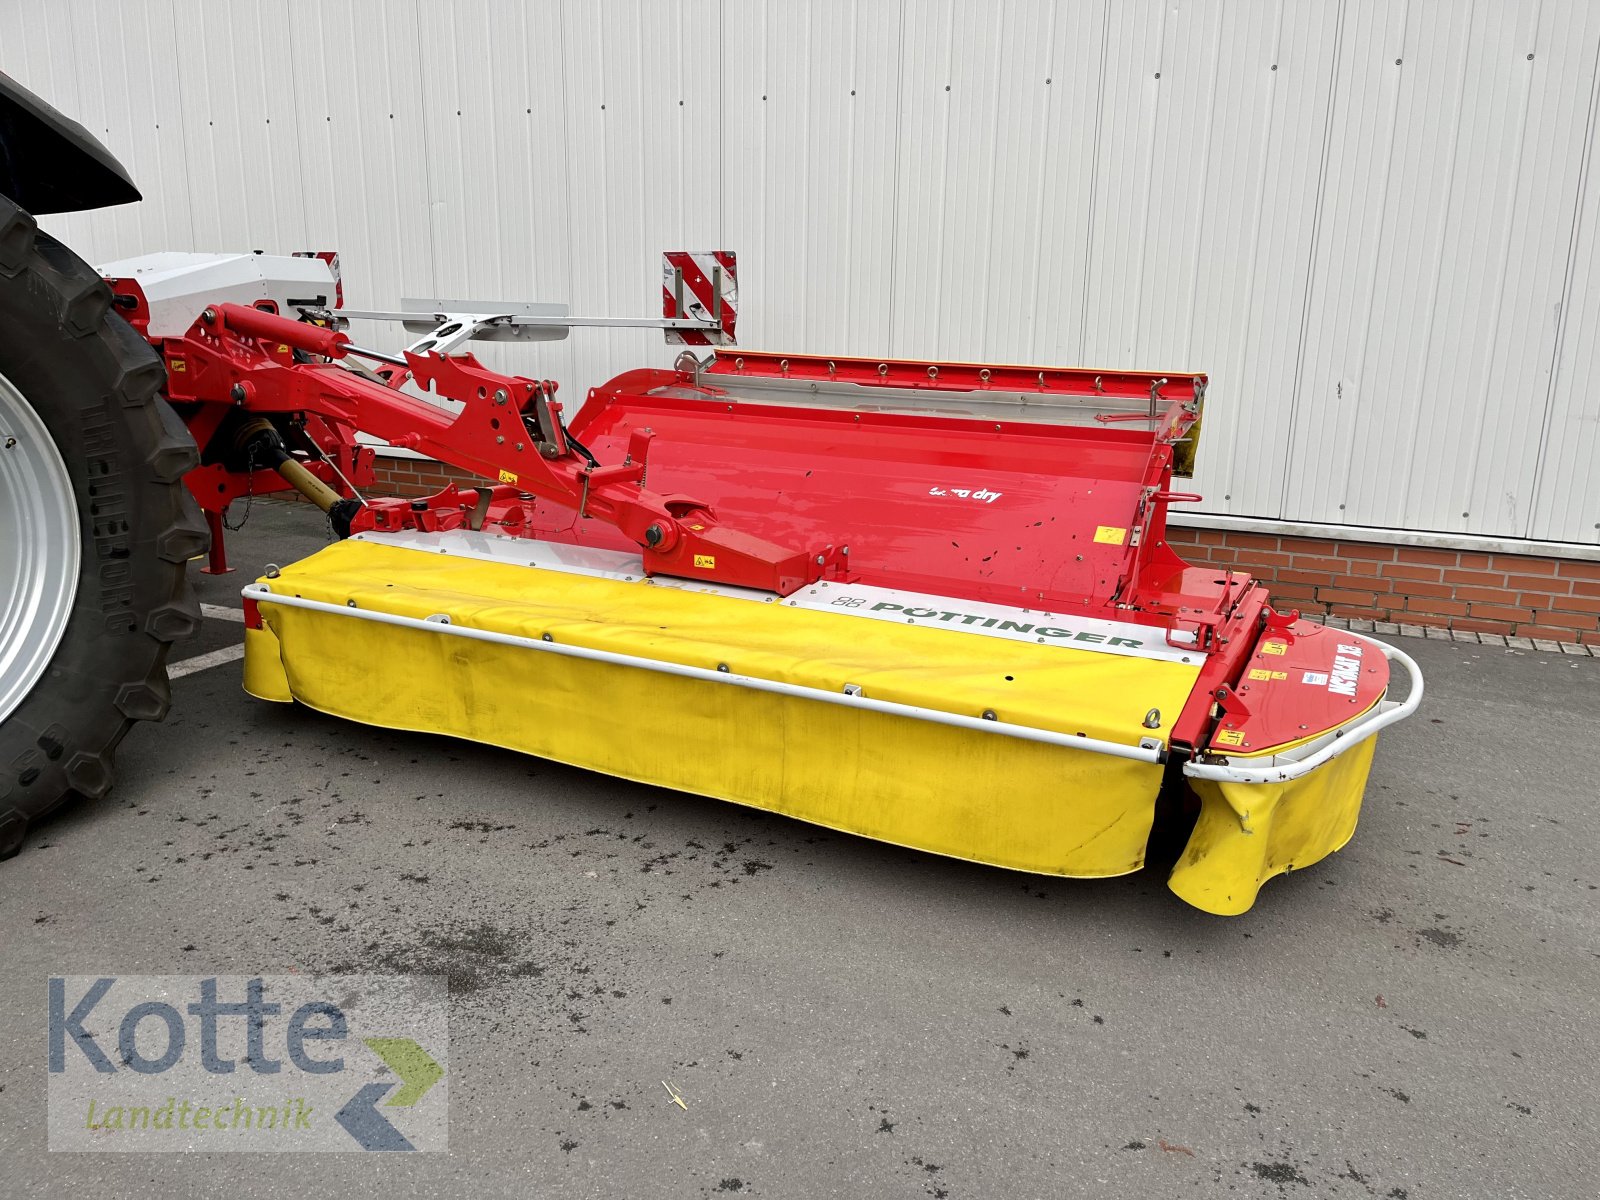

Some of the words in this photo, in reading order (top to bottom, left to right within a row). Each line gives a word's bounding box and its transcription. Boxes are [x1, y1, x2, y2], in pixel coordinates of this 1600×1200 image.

[80, 395, 139, 637] TRELLEBORG
[972, 488, 1003, 503] dry
[870, 601, 1144, 649] PÖTTINGER
